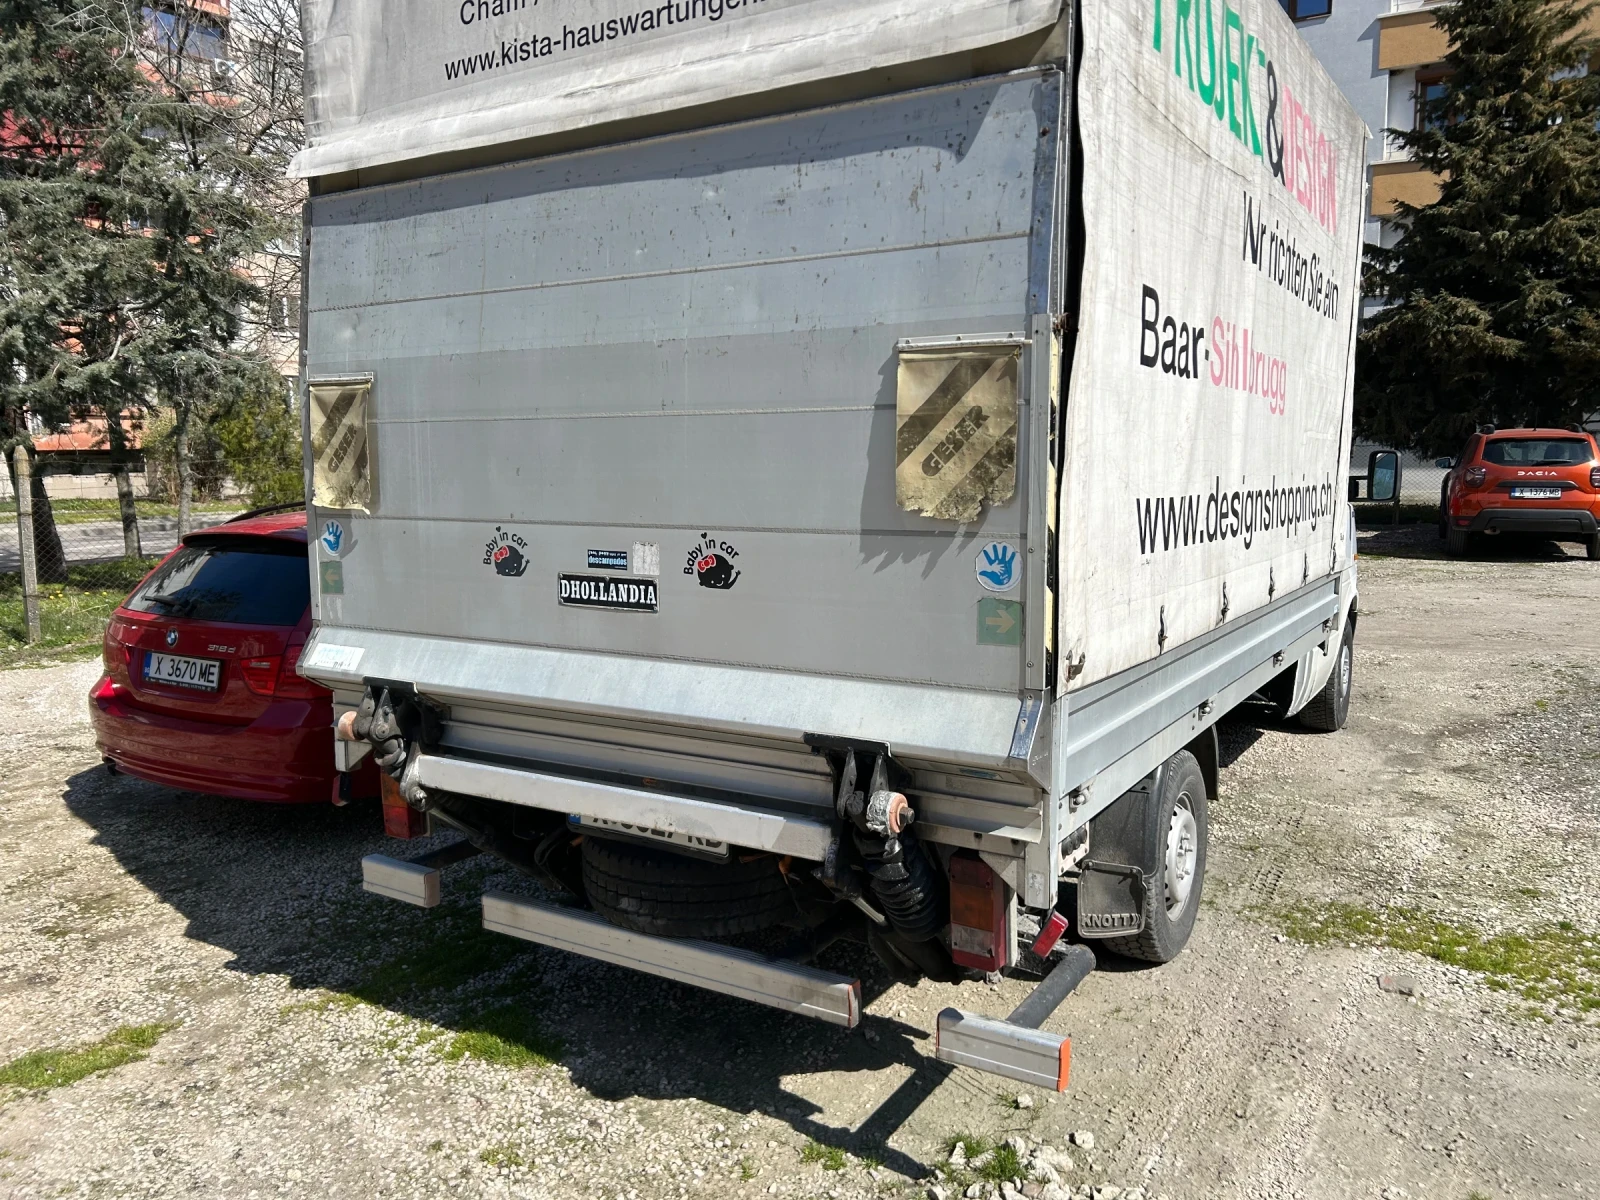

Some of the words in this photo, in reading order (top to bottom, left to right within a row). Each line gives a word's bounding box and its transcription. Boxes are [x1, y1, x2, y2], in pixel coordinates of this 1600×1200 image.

[1269, 219, 1307, 301] richten
[1308, 252, 1323, 312] Sie
[1323, 269, 1339, 321] ein
[922, 405, 991, 476] GESER
[1530, 488, 1548, 496] 1376
[1136, 472, 1332, 550] www.designshopping.ch
[483, 536, 499, 565] Baby
[511, 533, 528, 549] car
[683, 543, 703, 575] Baby
[720, 541, 740, 559] car
[560, 579, 657, 605] DHOLLANDIA
[154, 656, 164, 676] X
[167, 658, 197, 681] 3670
[198, 662, 217, 684] ME
[1082, 913, 1130, 928] KNOTT
